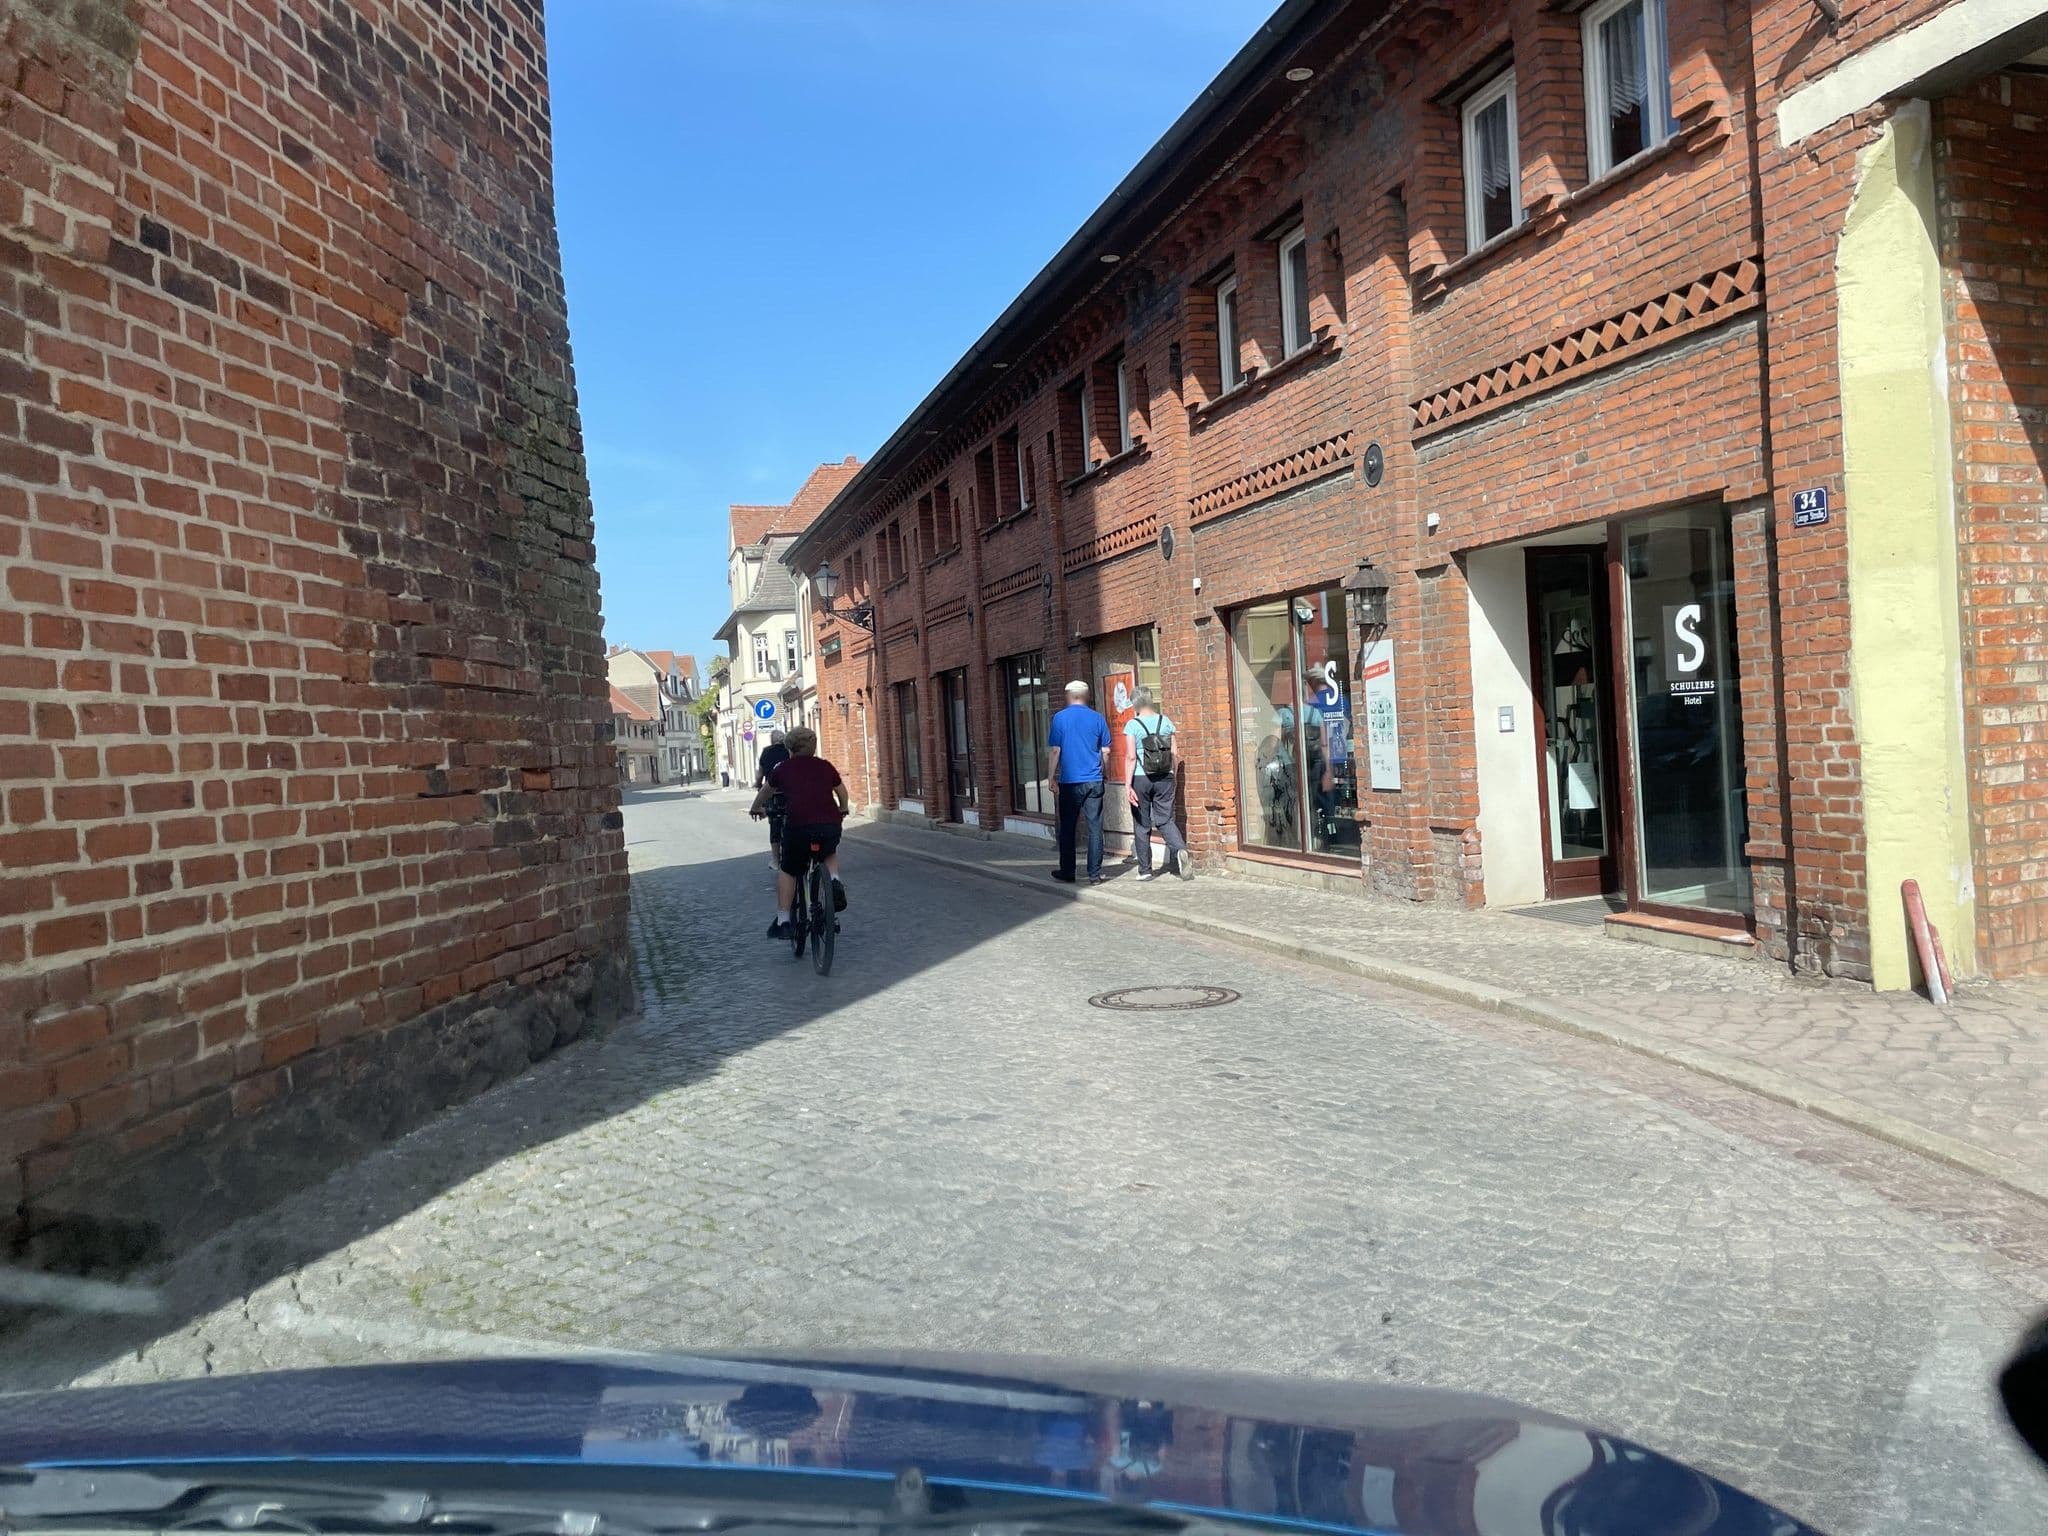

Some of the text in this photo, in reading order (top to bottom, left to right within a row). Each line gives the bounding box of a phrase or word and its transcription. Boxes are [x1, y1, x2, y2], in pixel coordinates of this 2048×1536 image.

[1800, 491, 1816, 509] 34
[1675, 604, 1705, 672] S
[1324, 661, 1339, 706] S
[1670, 680, 1715, 691] SCHULZENS
[1684, 696, 1702, 705] Hotel
